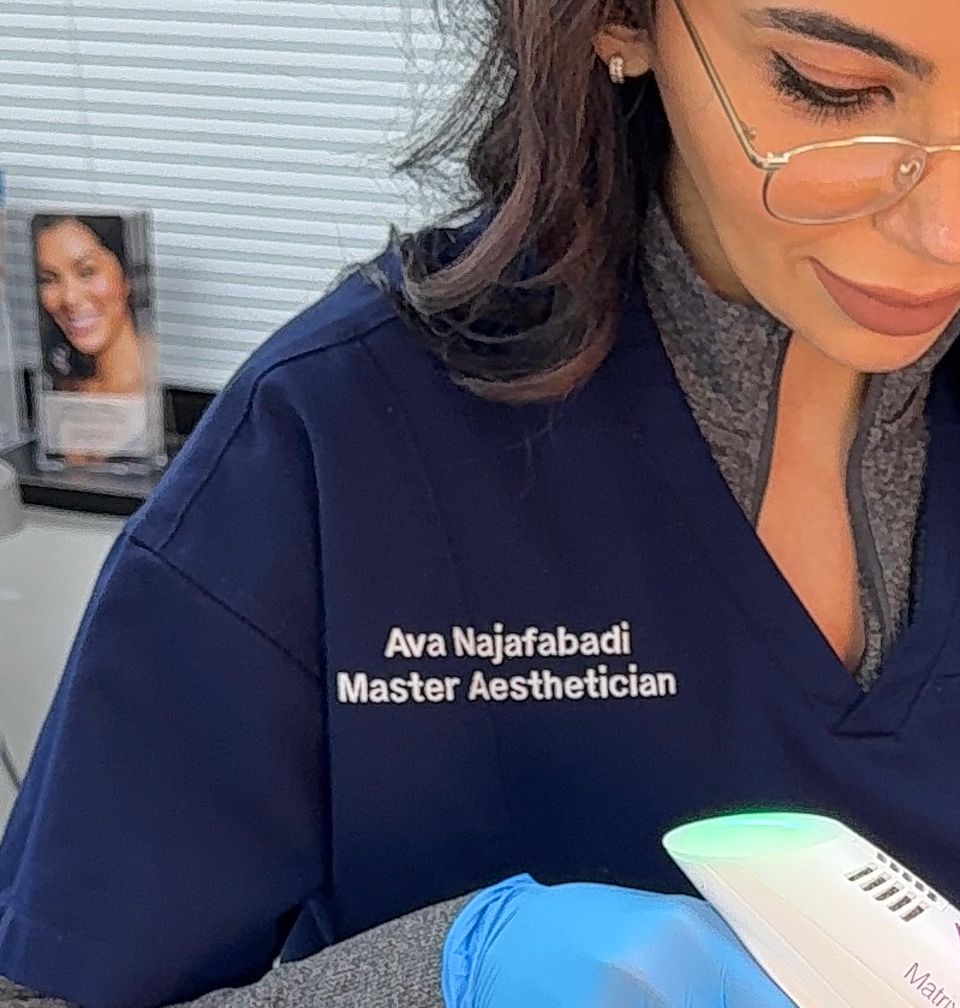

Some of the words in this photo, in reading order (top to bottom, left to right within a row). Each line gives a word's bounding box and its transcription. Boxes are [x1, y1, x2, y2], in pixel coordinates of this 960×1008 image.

[384, 627, 447, 657] Ava
[452, 621, 632, 664] Najafabadi
[336, 671, 460, 703] Master
[468, 664, 677, 700] Aesthetician
